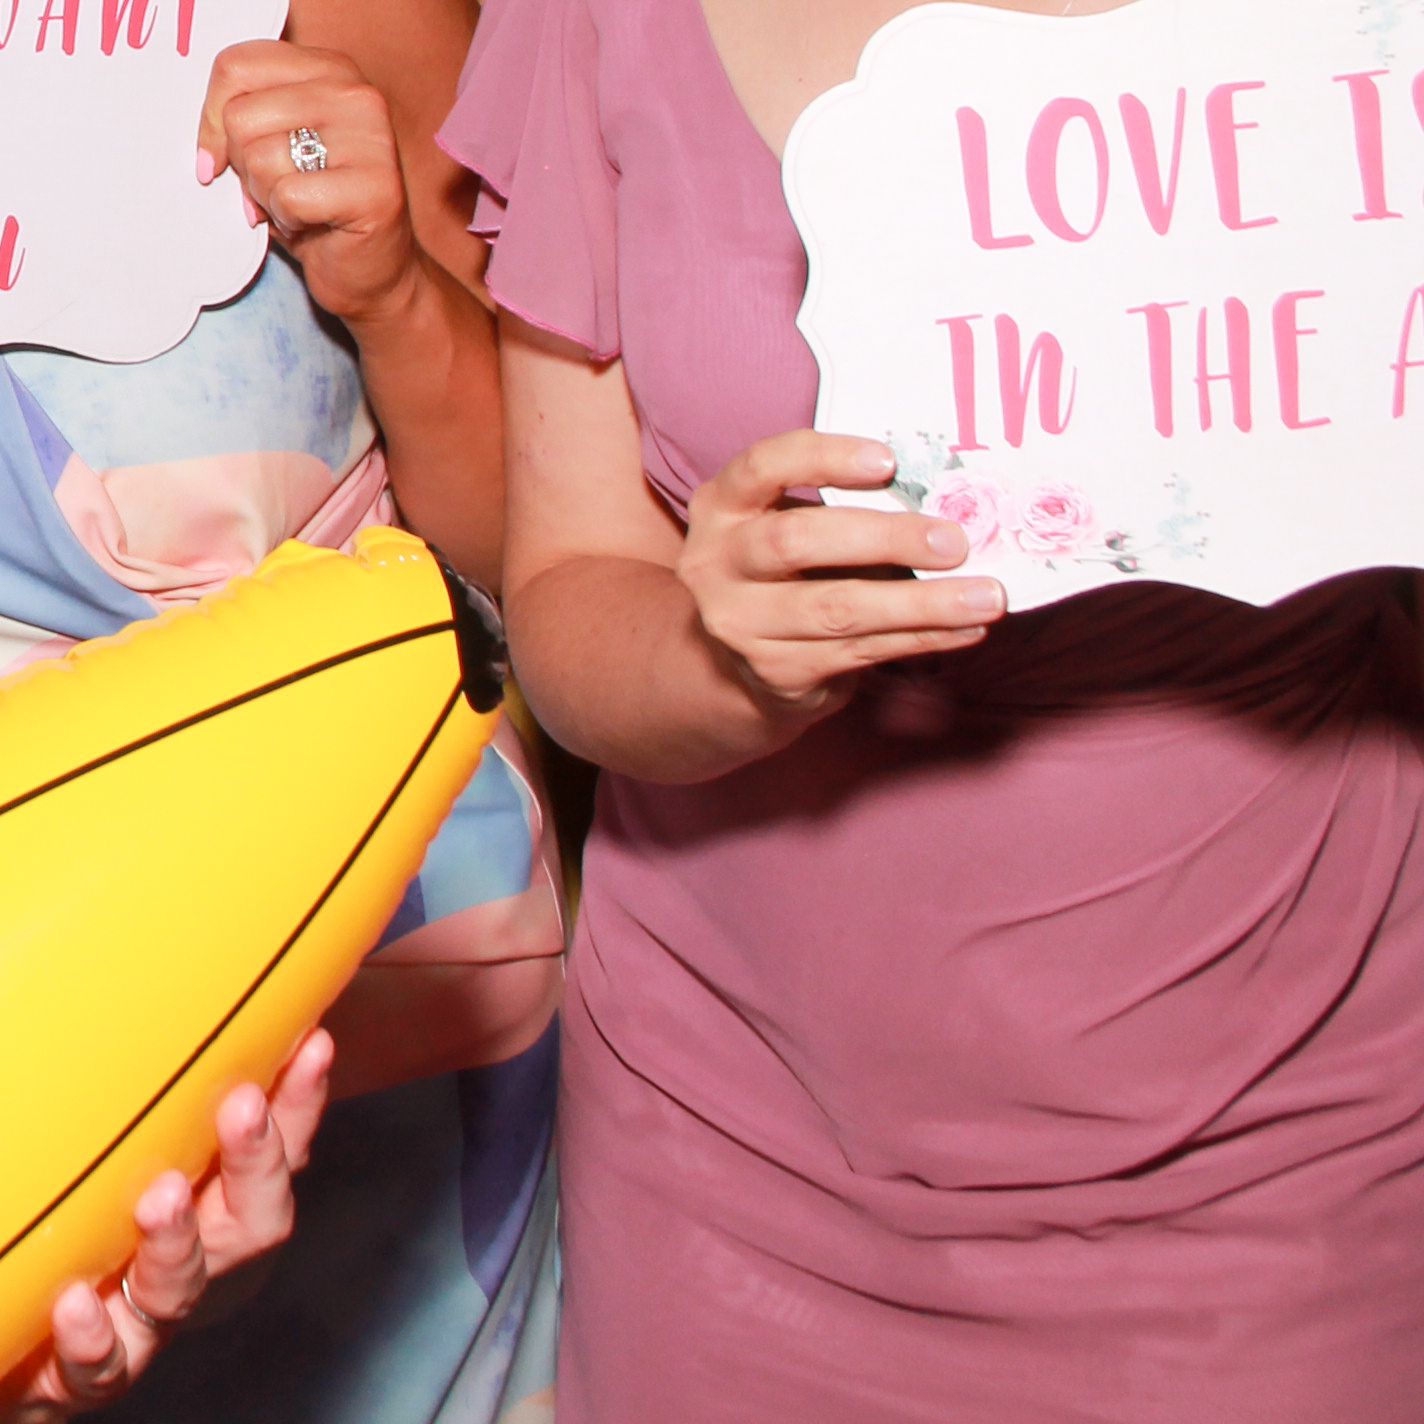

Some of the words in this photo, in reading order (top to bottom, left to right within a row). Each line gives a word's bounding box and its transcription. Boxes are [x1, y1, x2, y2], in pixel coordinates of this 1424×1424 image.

[955, 80, 1279, 251] LOVE
[1331, 69, 1424, 222] I
[1125, 289, 1332, 439] THE
